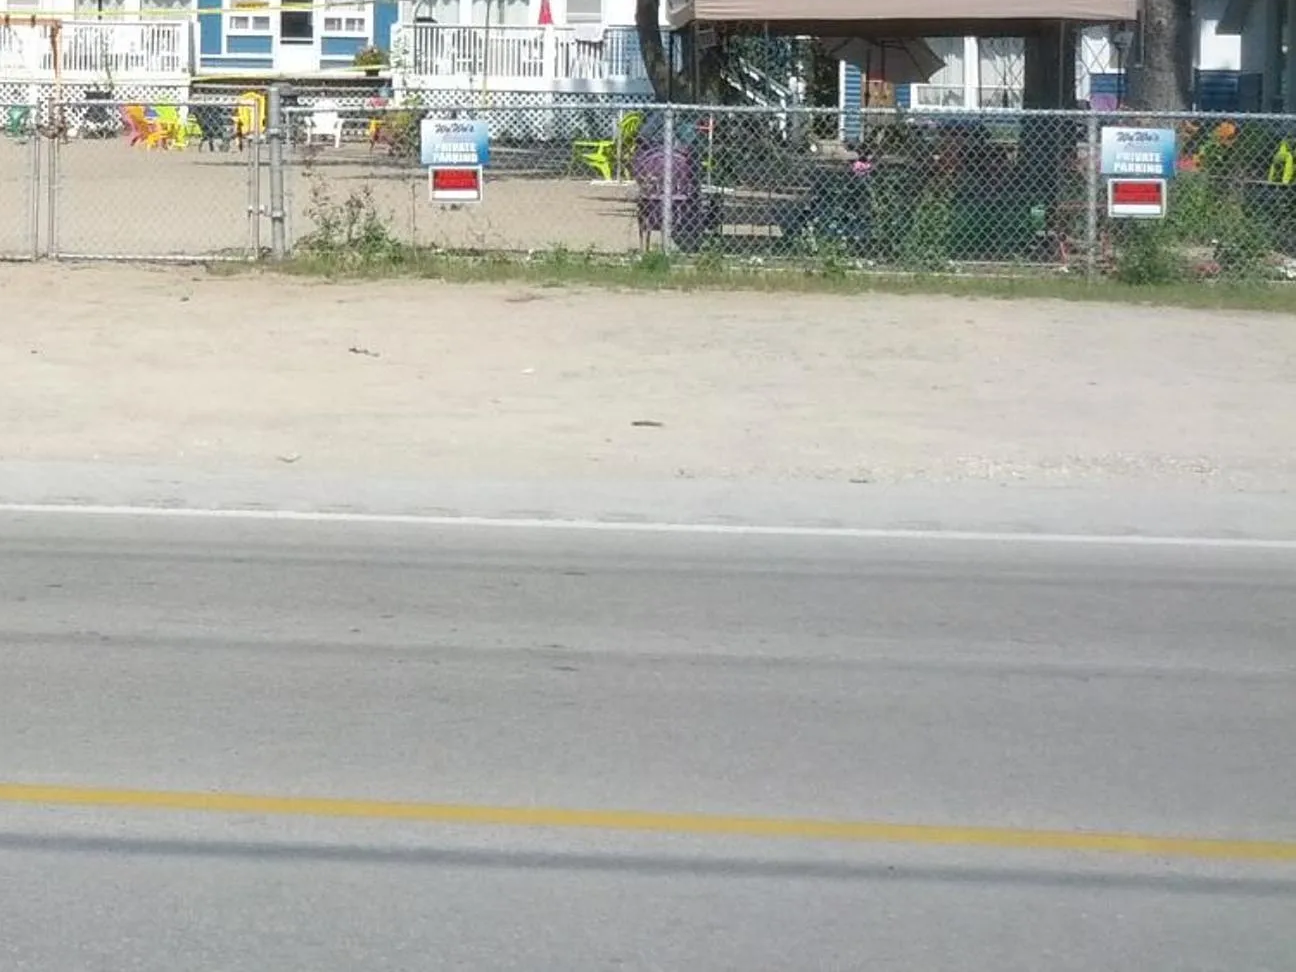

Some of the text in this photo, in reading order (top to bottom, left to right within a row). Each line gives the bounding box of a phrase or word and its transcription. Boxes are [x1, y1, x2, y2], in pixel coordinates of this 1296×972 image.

[434, 142, 477, 151] PRIVATE
[433, 152, 478, 163] PARKING
[1115, 152, 1161, 162] PRIVATE
[1113, 163, 1164, 174] PARKING
